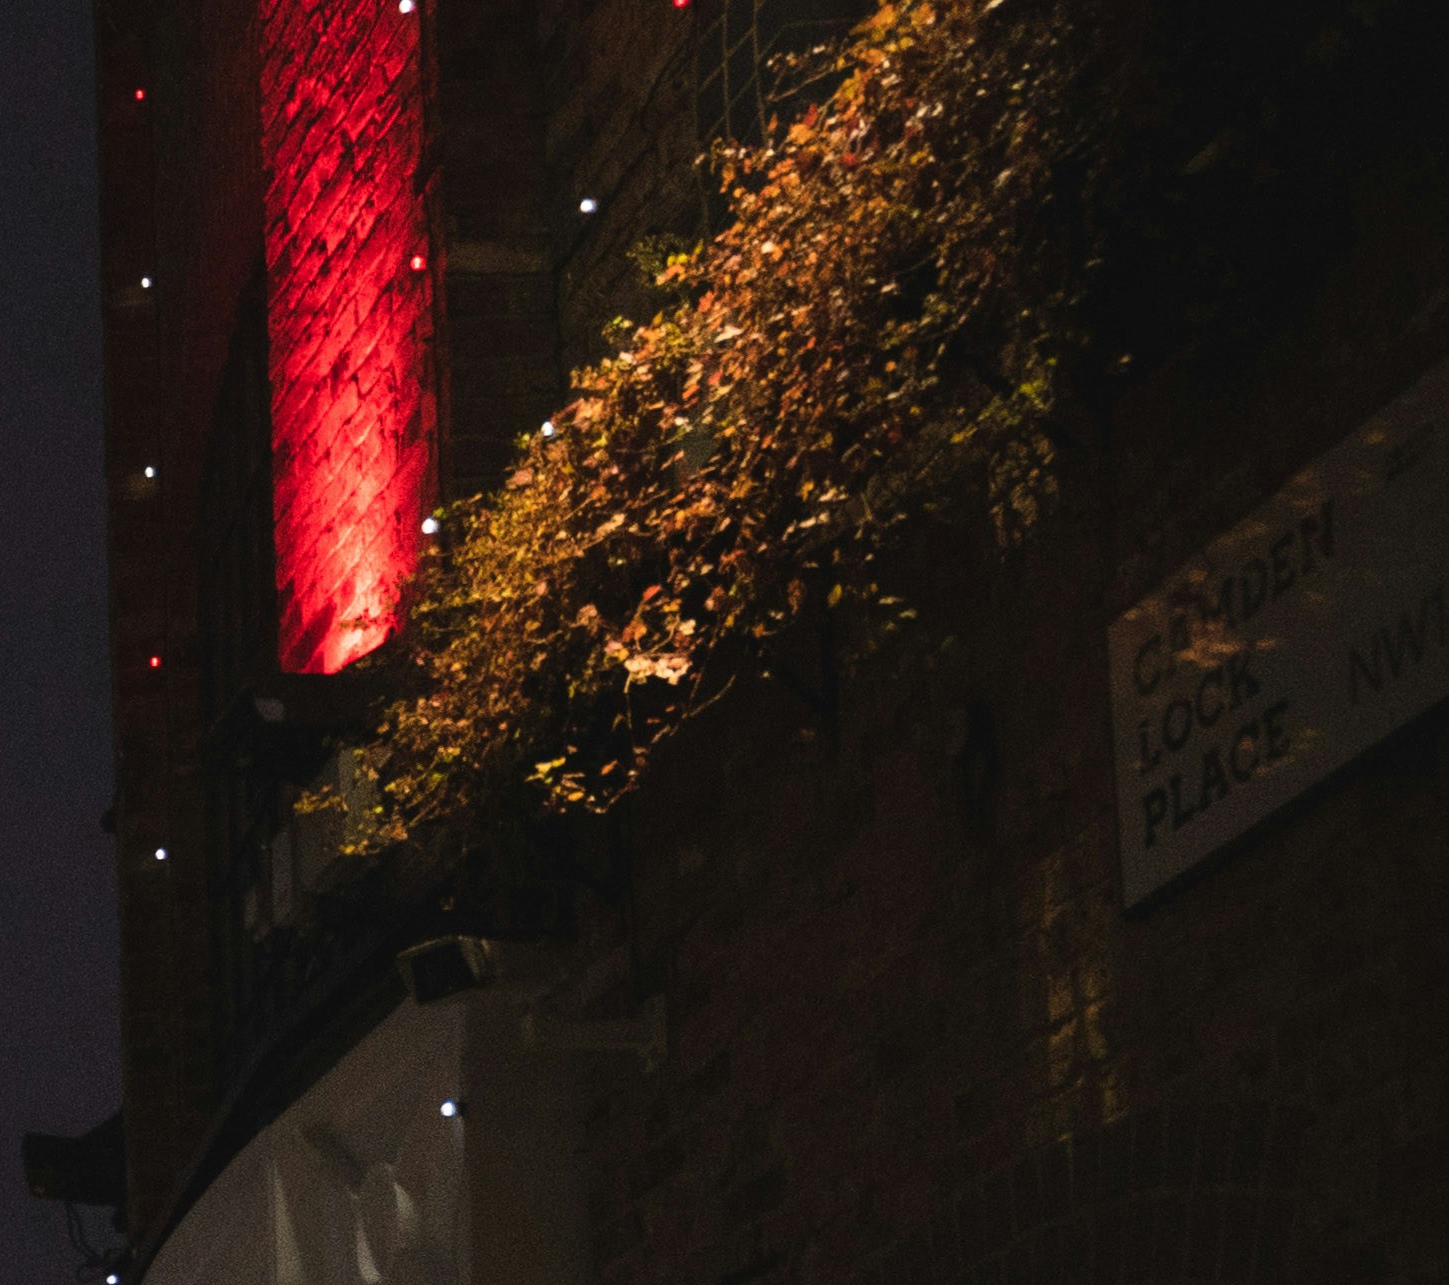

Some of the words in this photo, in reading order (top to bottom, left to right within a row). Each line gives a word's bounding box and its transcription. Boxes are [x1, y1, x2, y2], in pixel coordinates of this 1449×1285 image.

[1141, 656, 1260, 776] LOCK
[1349, 584, 1446, 704] NW1
[1144, 700, 1290, 848] PLACE
